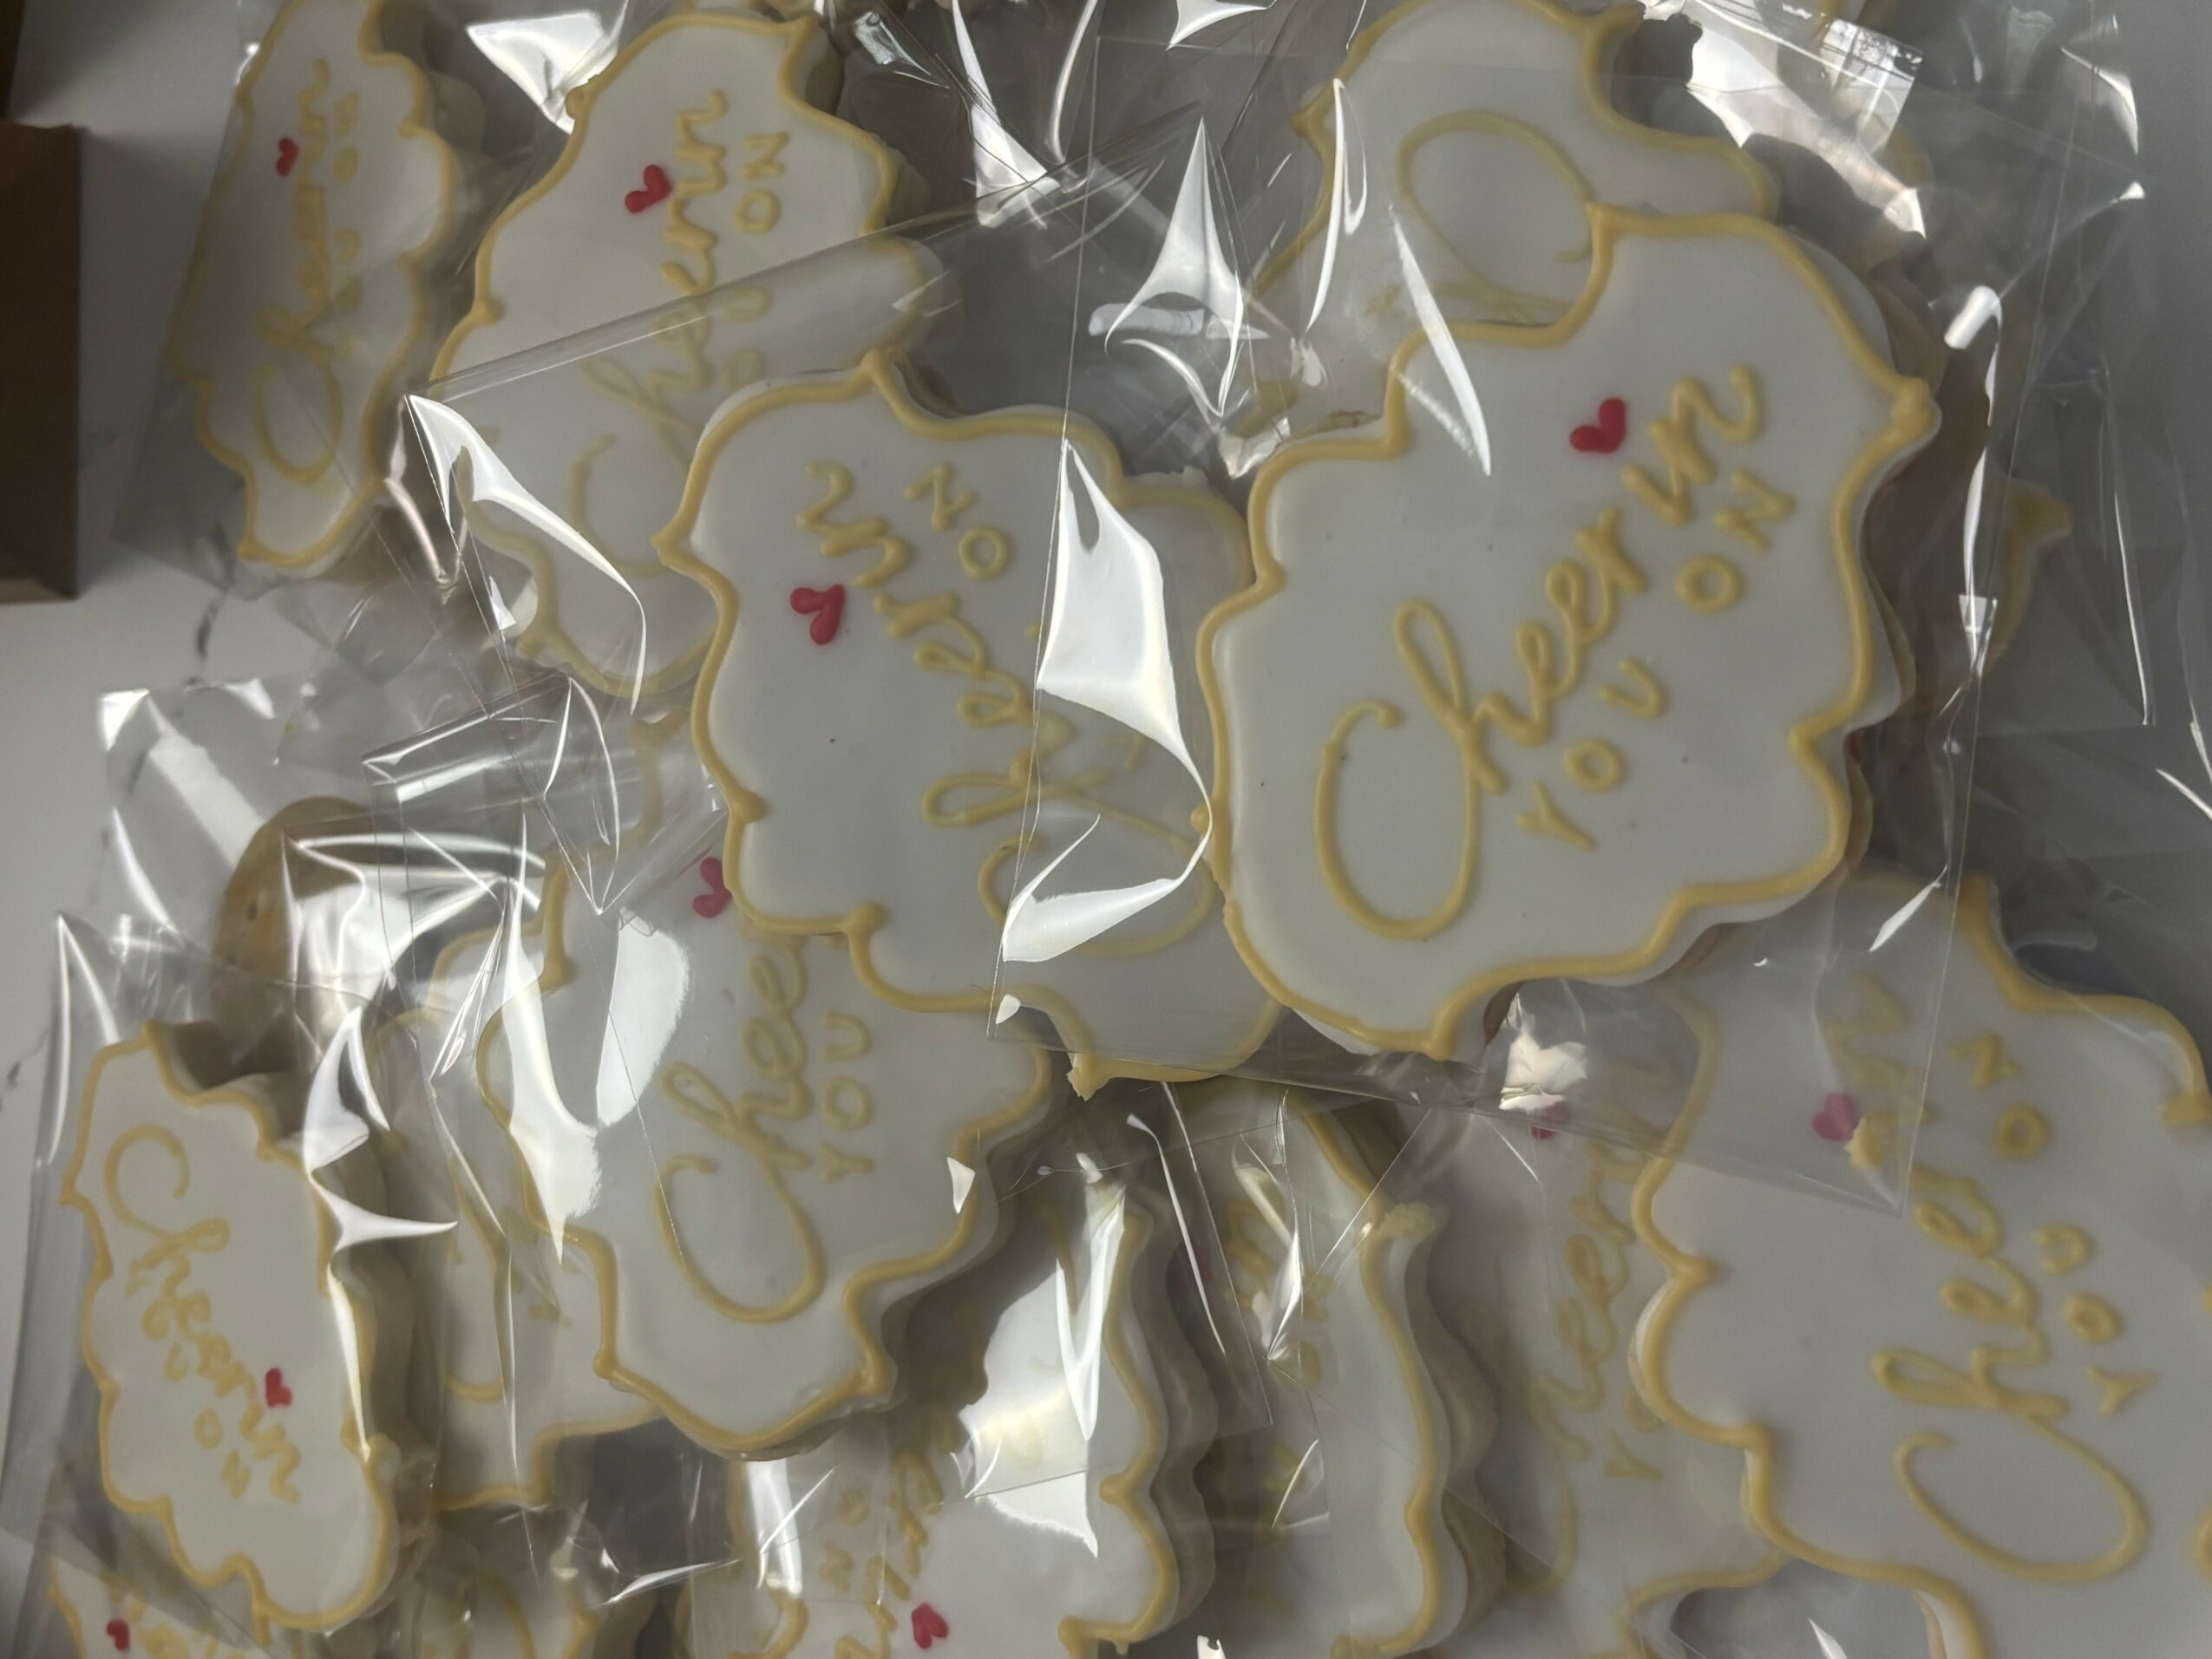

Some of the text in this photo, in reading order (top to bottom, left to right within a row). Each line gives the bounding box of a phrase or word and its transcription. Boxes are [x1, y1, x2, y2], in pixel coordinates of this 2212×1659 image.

[1516, 456, 1796, 852] YOU ON
[817, 1009, 874, 1183] YOU
